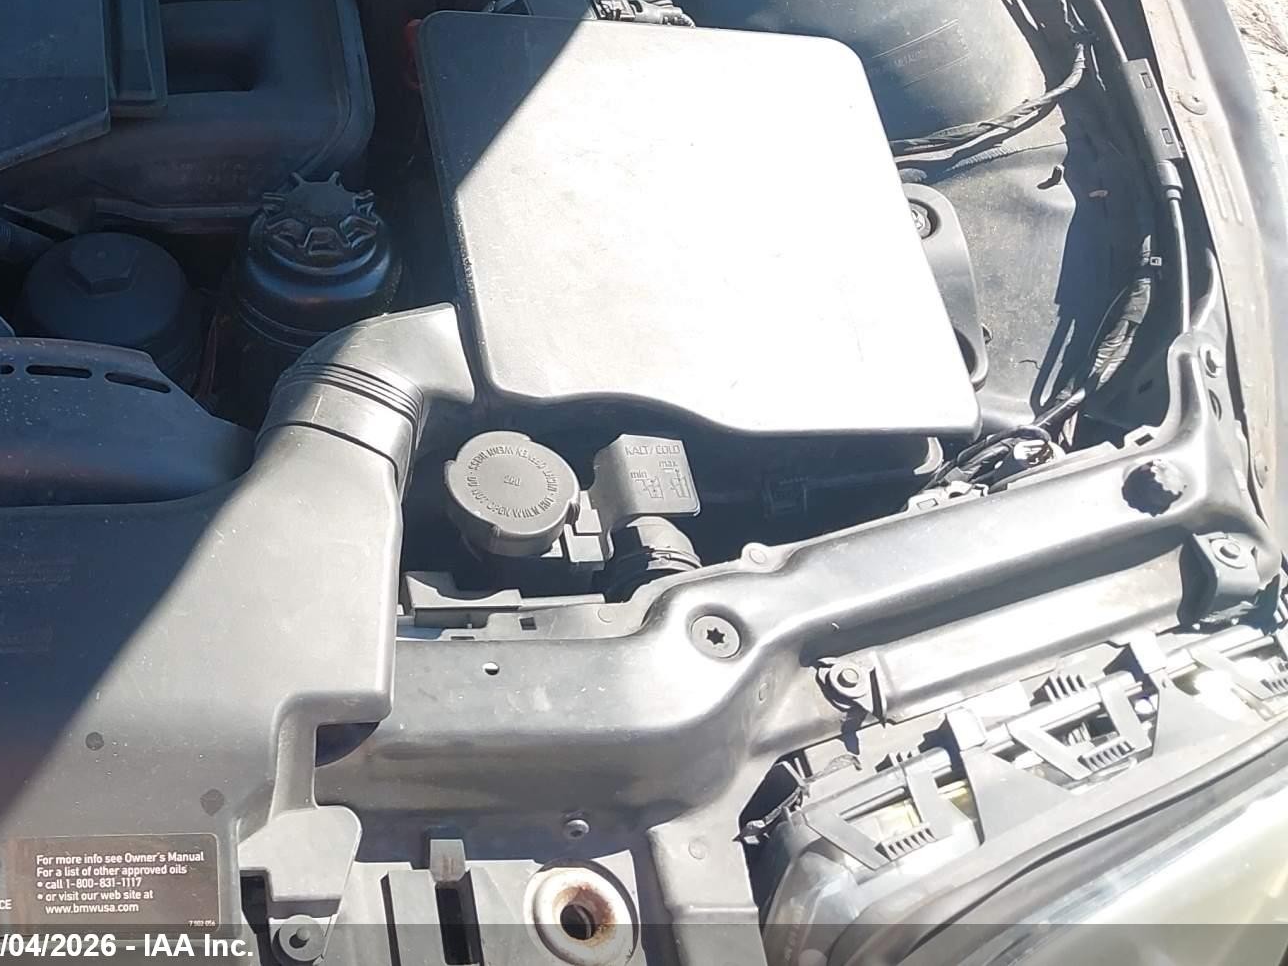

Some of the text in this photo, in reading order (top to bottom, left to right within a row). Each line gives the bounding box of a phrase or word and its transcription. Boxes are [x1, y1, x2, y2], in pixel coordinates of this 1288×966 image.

[630, 469, 647, 479] min
[36, 851, 204, 865] For more info see Owner's Manual
[36, 867, 53, 877] For
[65, 866, 79, 876] list
[82, 866, 91, 876] of
[93, 865, 119, 875] other
[122, 864, 167, 877] approved
[169, 864, 187, 874] oils
[45, 877, 142, 889] call 1-800-831-1117
[45, 889, 154, 901] or visit our web site at
[45, 902, 139, 914] www.bmwusa.com
